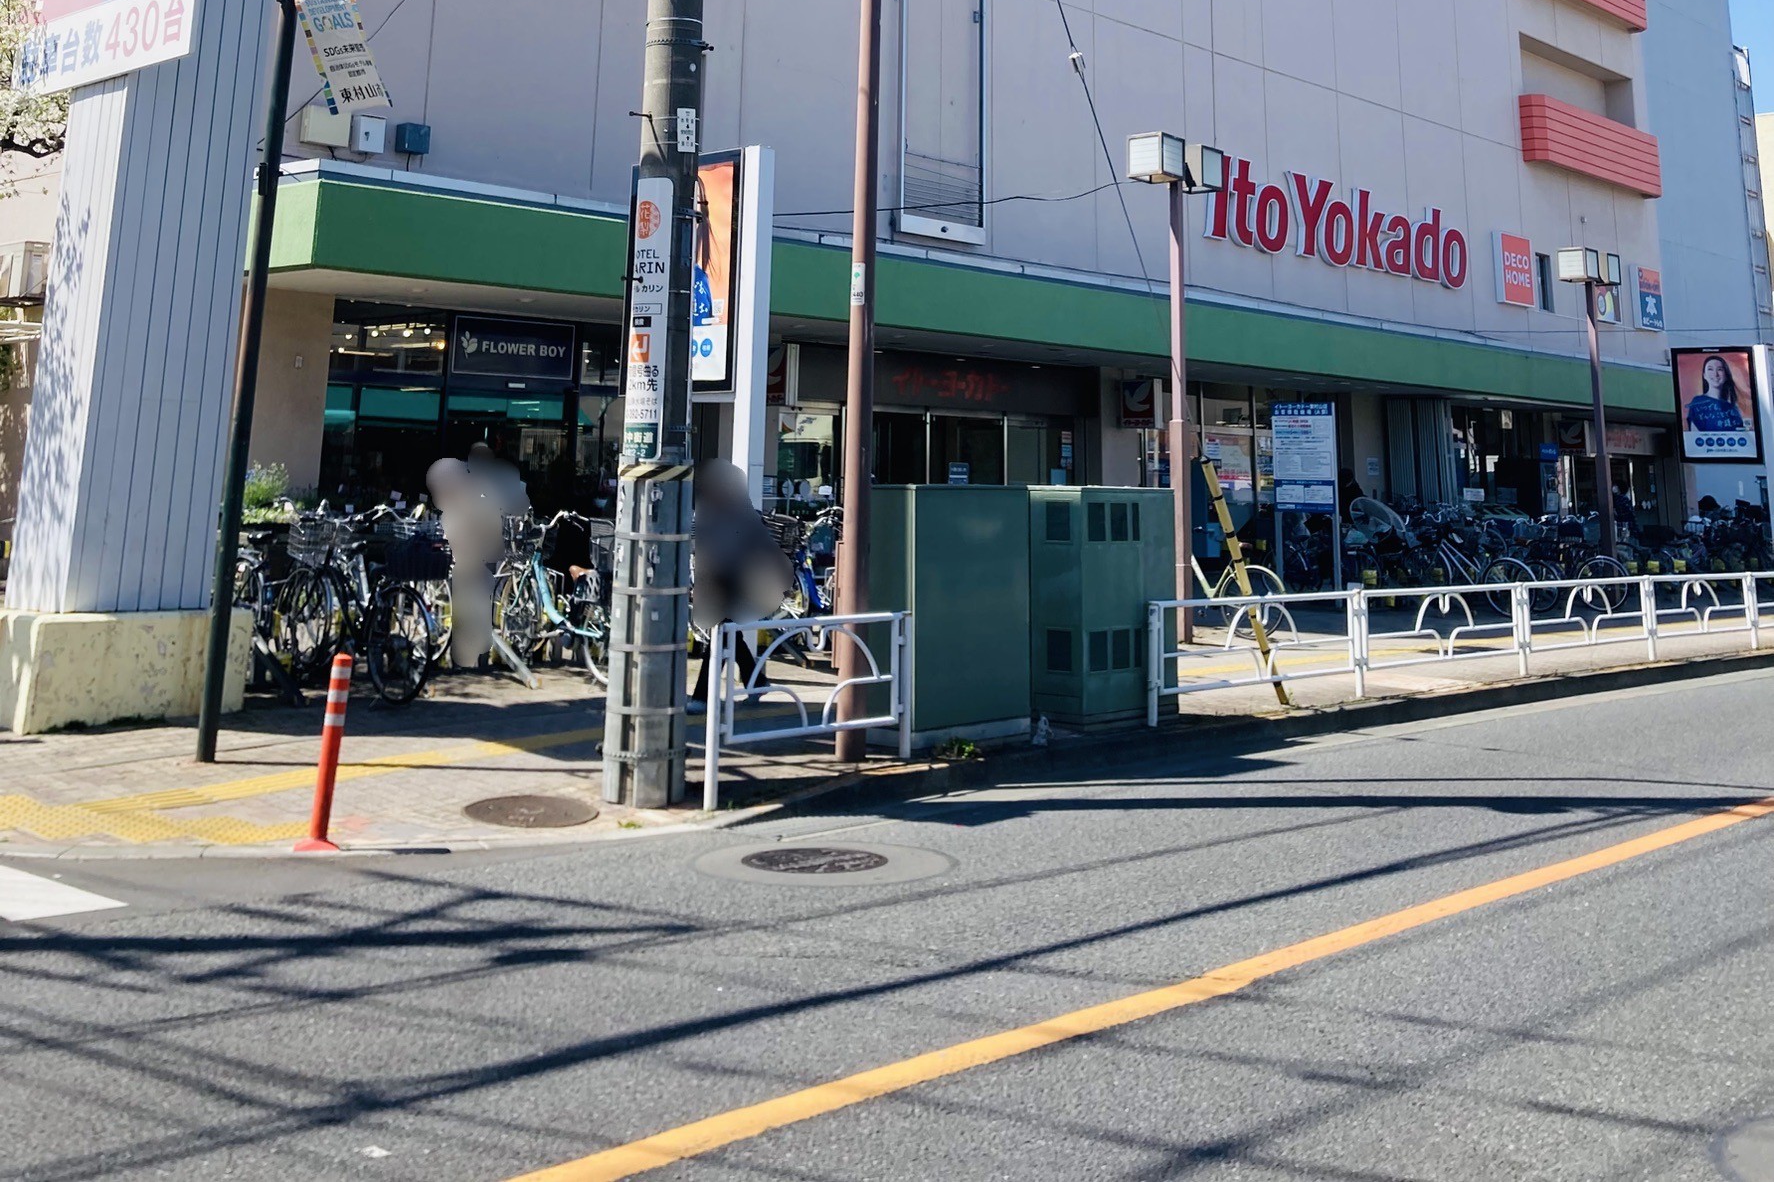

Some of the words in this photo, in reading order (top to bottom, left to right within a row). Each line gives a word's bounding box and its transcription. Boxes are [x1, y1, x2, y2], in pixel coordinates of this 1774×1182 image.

[313, 12, 354, 33] GOALS
[1504, 251, 1530, 269] DECO
[1505, 269, 1531, 288] HOME
[481, 340, 536, 357] FLOWER
[539, 344, 567, 359] BOY
